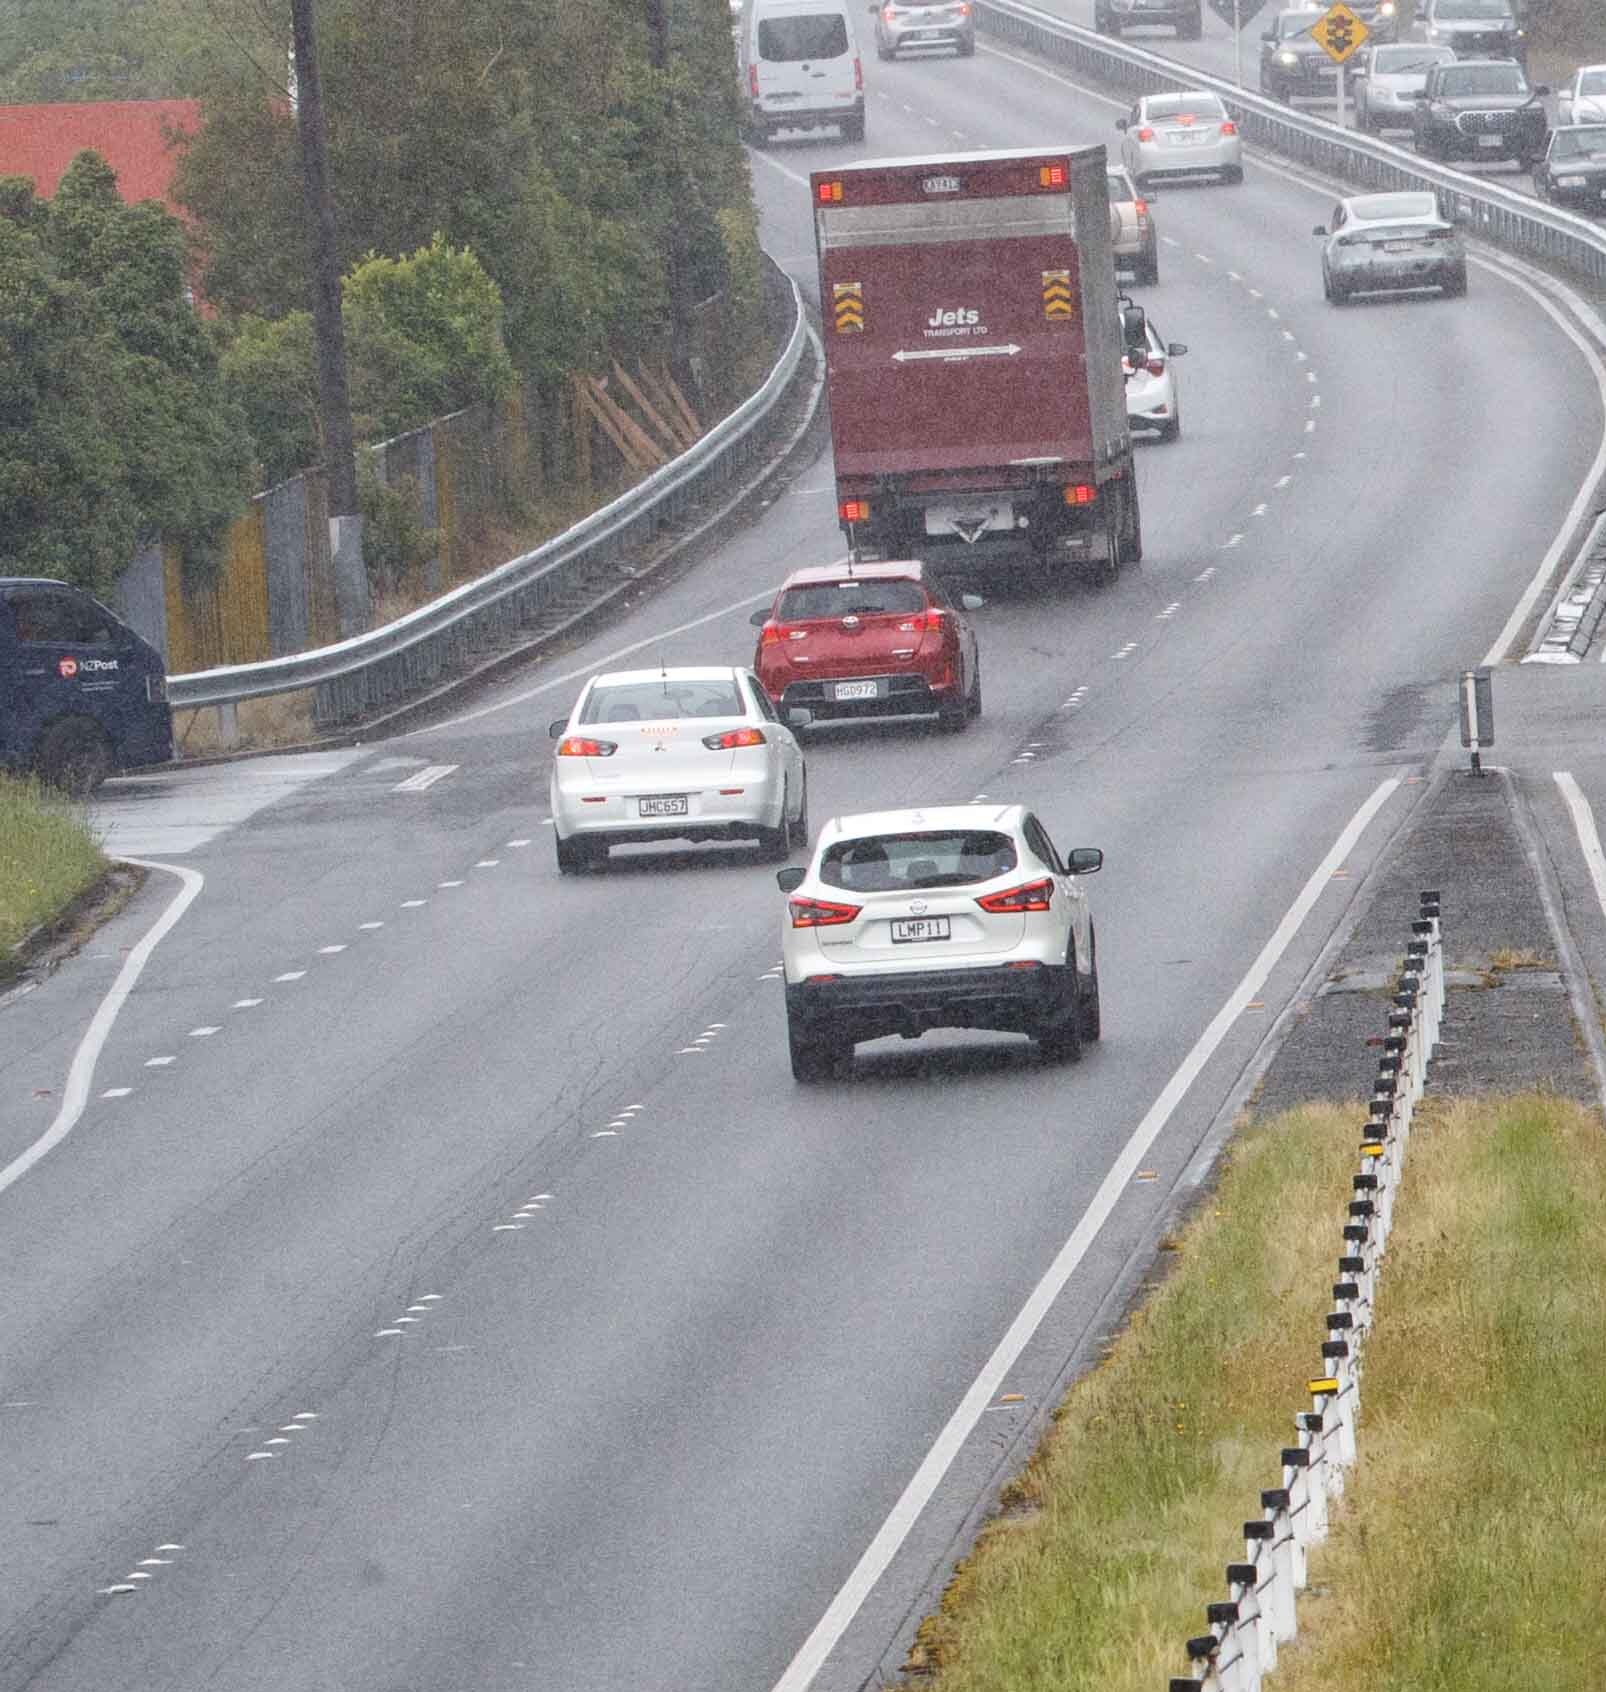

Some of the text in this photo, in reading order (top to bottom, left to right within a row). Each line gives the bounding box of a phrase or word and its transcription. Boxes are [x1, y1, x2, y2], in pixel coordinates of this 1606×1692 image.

[928, 307, 979, 327] Jets
[923, 325, 989, 337] TRANSPORT LTD
[641, 800, 686, 814] JHC657
[898, 919, 943, 938] LMP11
